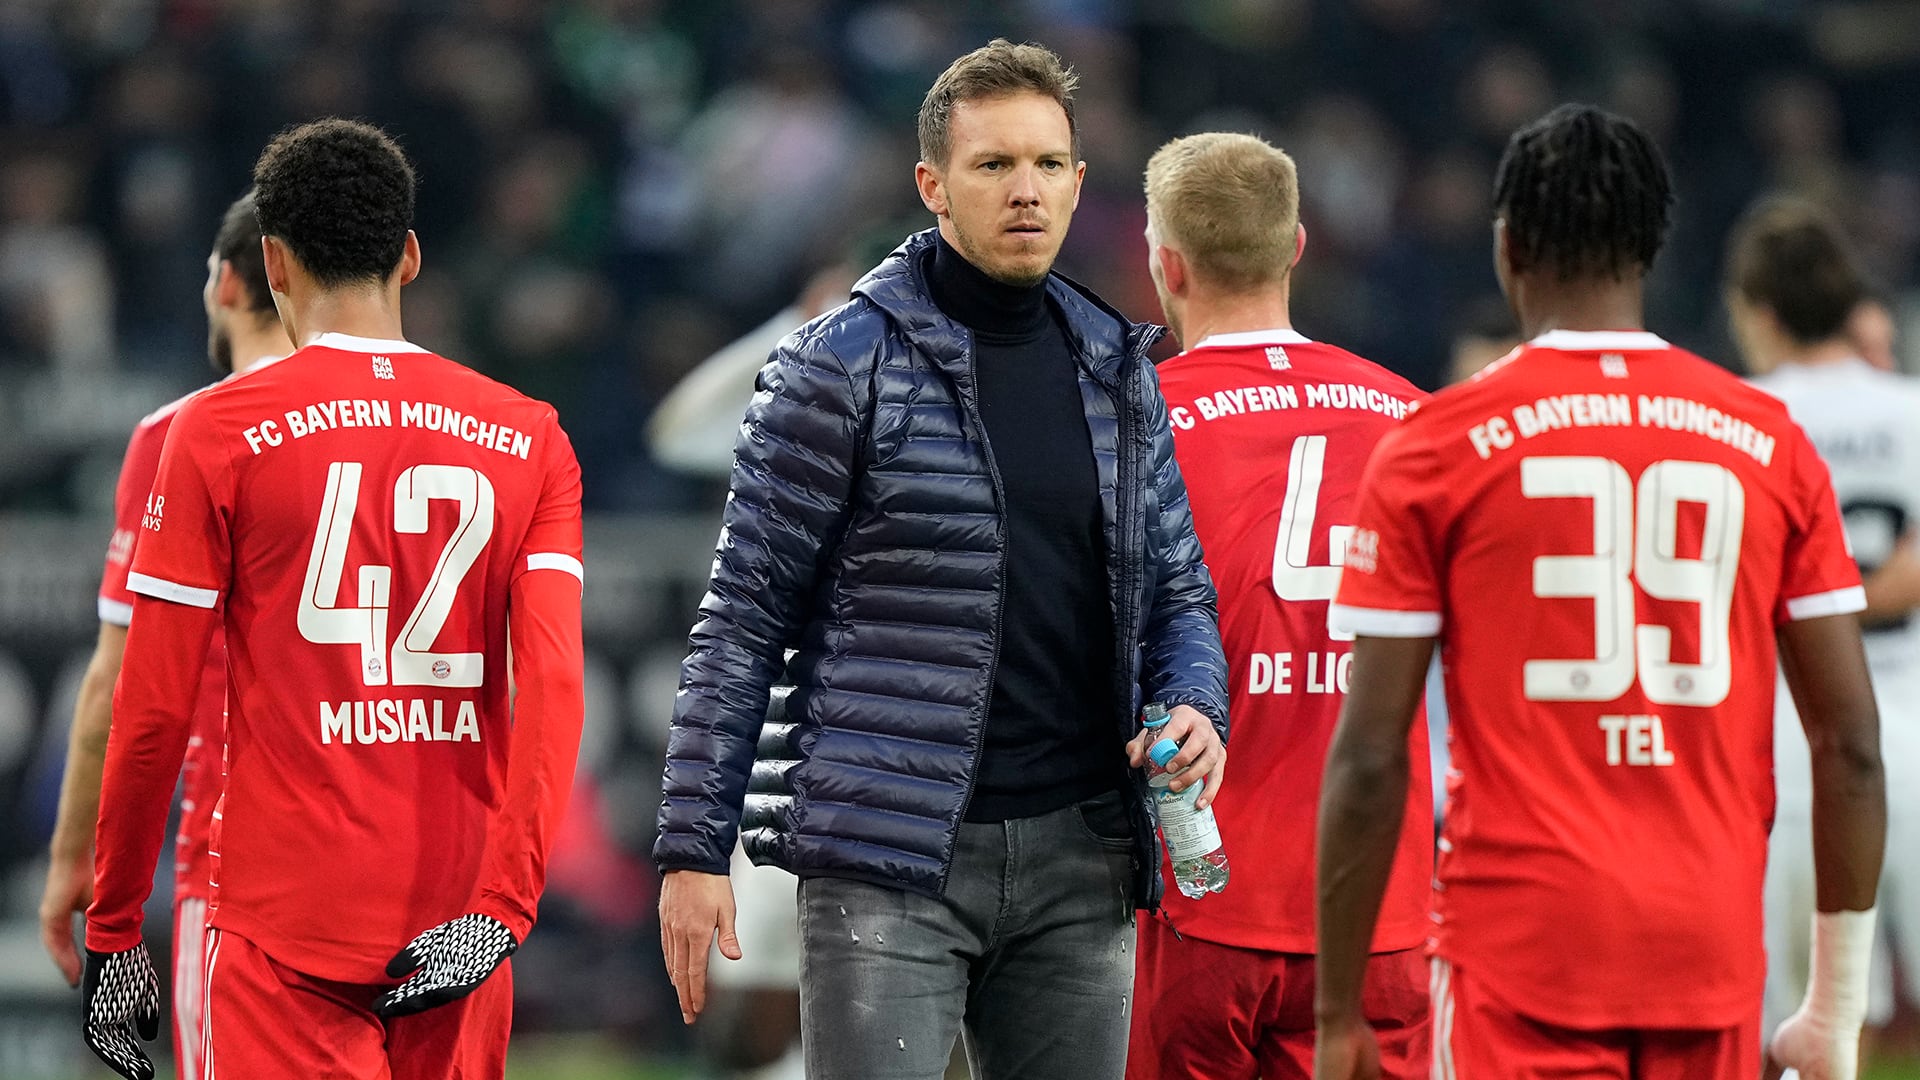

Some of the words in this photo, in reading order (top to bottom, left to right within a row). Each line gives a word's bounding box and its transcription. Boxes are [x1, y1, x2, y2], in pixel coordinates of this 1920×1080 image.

[372, 356, 391, 365] MIA
[375, 371, 396, 379] MIA
[1194, 385, 1299, 421] BAYERN
[1306, 383, 1421, 421] MÜNCHE
[243, 420, 283, 455] FC
[285, 400, 392, 438] BAYERN
[401, 399, 532, 460] MÜNCHEN
[1468, 417, 1514, 459] FC
[1513, 394, 1633, 438] BAYERN
[1638, 394, 1776, 467] MÜNCHEN
[297, 462, 495, 687] 42
[1521, 456, 1745, 707] 39
[1249, 652, 1293, 695] DE
[320, 699, 480, 745] MUSIALA
[1599, 714, 1675, 767] TEL
